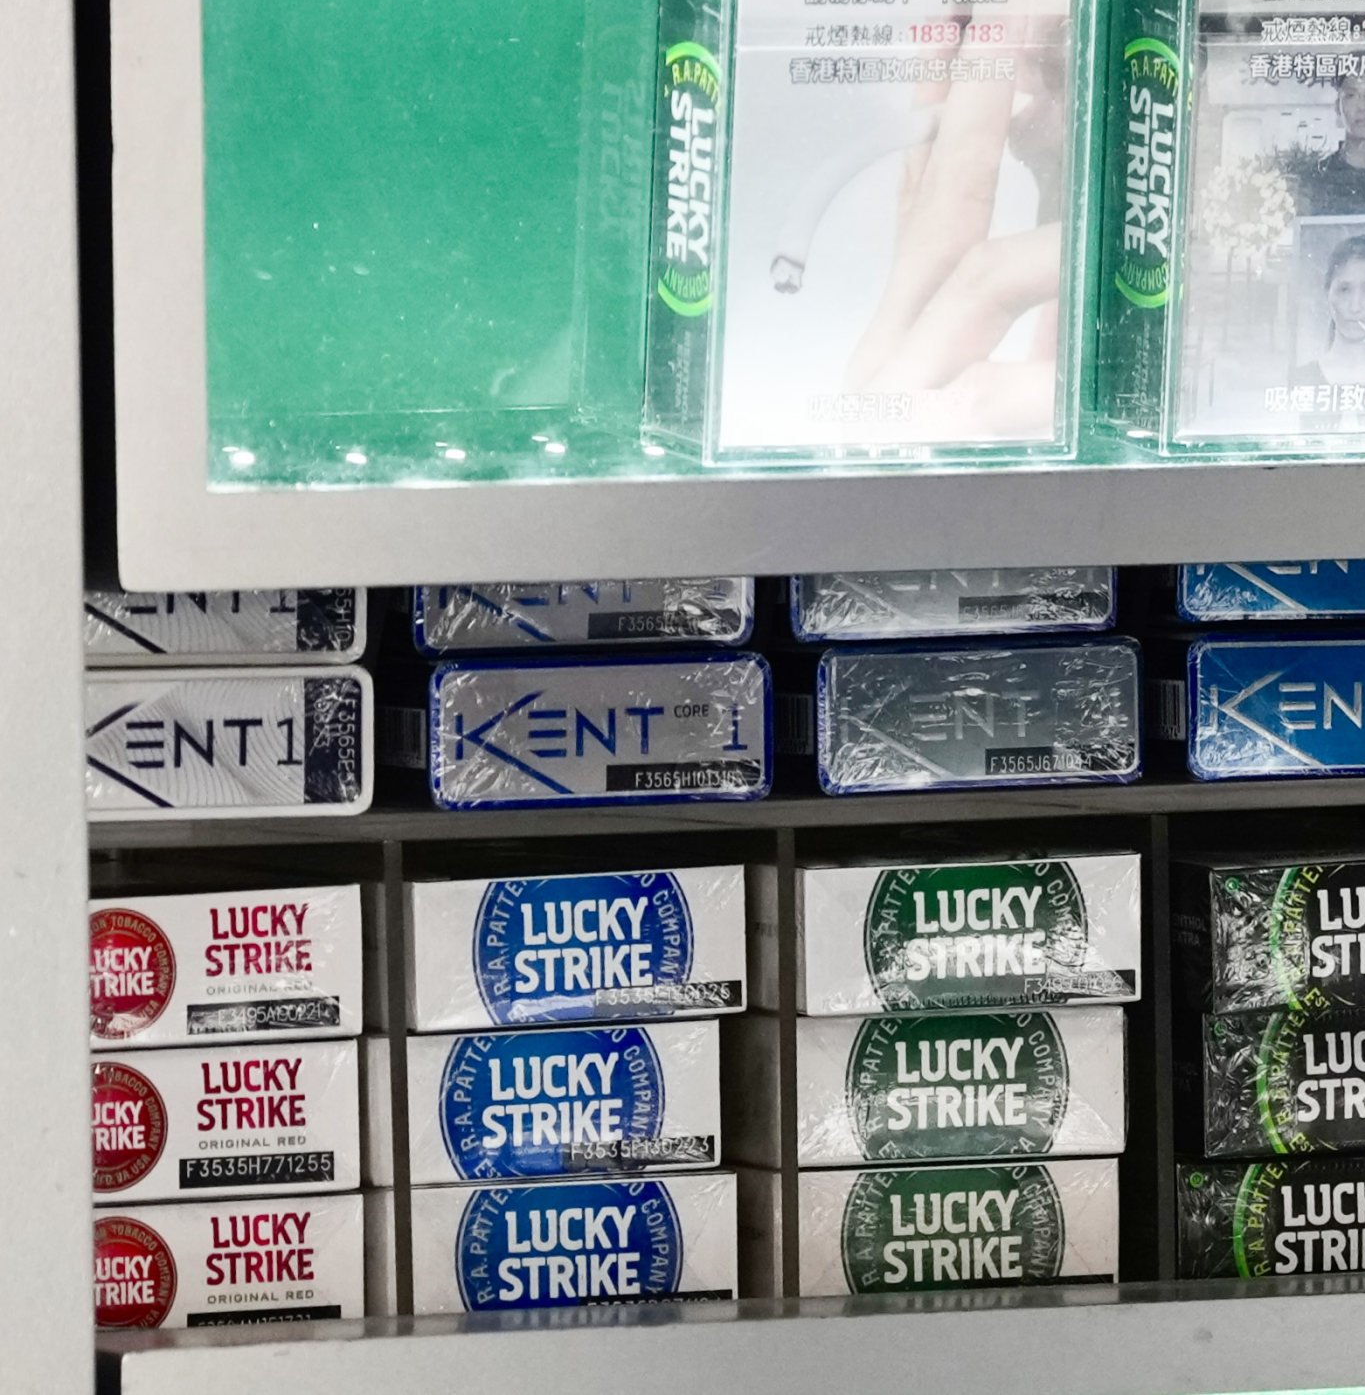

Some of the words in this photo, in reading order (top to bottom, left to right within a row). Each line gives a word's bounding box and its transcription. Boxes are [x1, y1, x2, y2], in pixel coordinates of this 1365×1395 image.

[908, 24, 957, 44] 1833
[967, 23, 1005, 43] 183
[790, 57, 1016, 84] 香港特區政府忠告市民
[666, 90, 691, 263] STRIKE
[686, 106, 716, 265] LUCKY
[1123, 84, 1151, 255] STRIKE
[1146, 101, 1175, 259] LUCKY
[454, 690, 665, 794] KENT
[673, 705, 709, 719] CORE
[210, 902, 309, 941] LUCKY
[519, 896, 649, 946] LUCKY
[913, 885, 1042, 934] LUCKY
[205, 939, 313, 979] STRIKE
[513, 942, 654, 995] STRIKE
[905, 931, 1046, 982] STRIKE
[201, 1057, 302, 1095] LUCKY
[488, 1052, 619, 1102] LUCKY
[895, 1037, 1024, 1083] LUCKY
[196, 1094, 306, 1133] STRIKE
[482, 1098, 624, 1150] STRIKE
[886, 1082, 1028, 1132] STRIKE
[186, 1150, 332, 1179] F3535H771255
[198, 1136, 271, 1151] ORIGINAL
[277, 1134, 307, 1147] RED
[210, 1211, 311, 1249] LUCKY
[504, 1204, 637, 1254] LUCKY
[889, 1188, 1020, 1237] LUCKY
[205, 1248, 315, 1287] STRIKE
[498, 1251, 641, 1302] STRIKE
[882, 1236, 1023, 1285] STRIKE
[207, 1291, 279, 1305] ORIGINAL
[285, 1288, 315, 1302] RED
